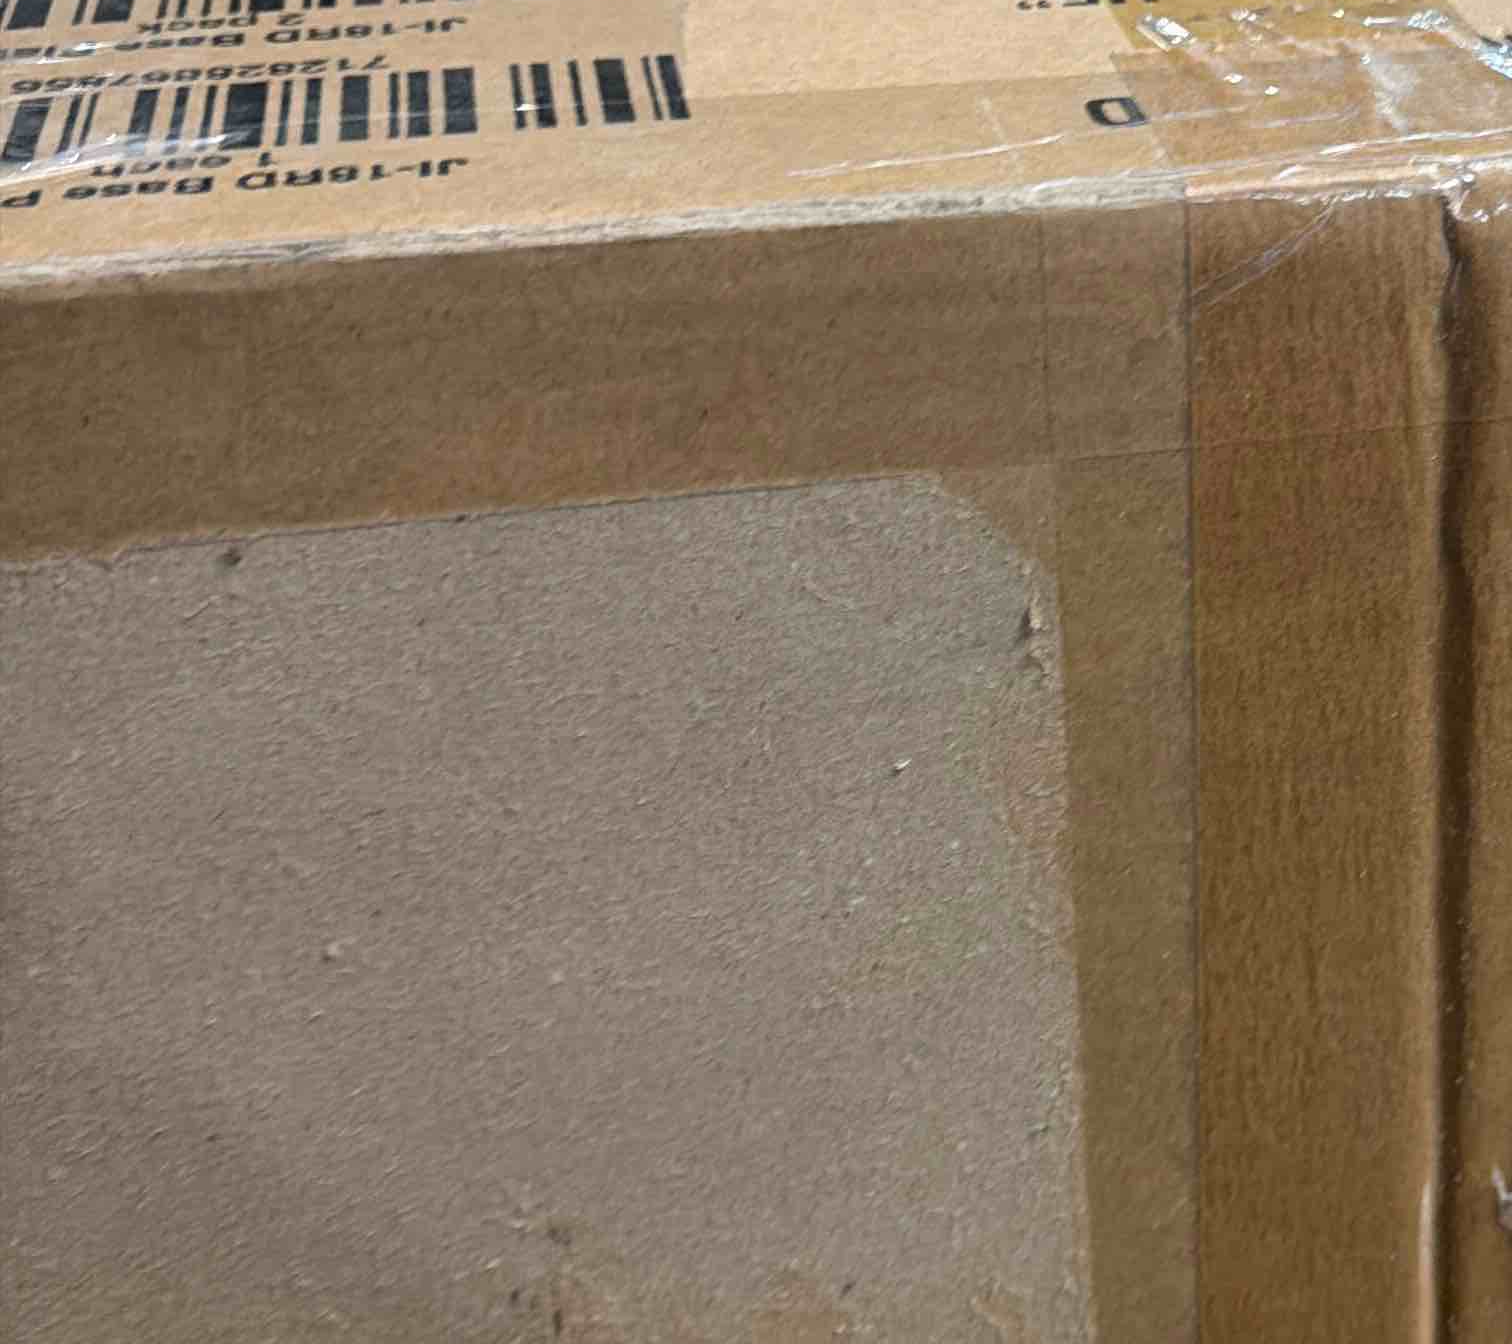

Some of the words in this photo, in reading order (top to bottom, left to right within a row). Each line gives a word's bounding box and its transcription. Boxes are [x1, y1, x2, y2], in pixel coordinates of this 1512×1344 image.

[137, 11, 262, 37] pack
[281, 12, 306, 27] 2
[113, 32, 247, 54] Base
[88, 155, 233, 179] each
[235, 158, 470, 191] JI-18RD
[62, 174, 216, 202] Base
